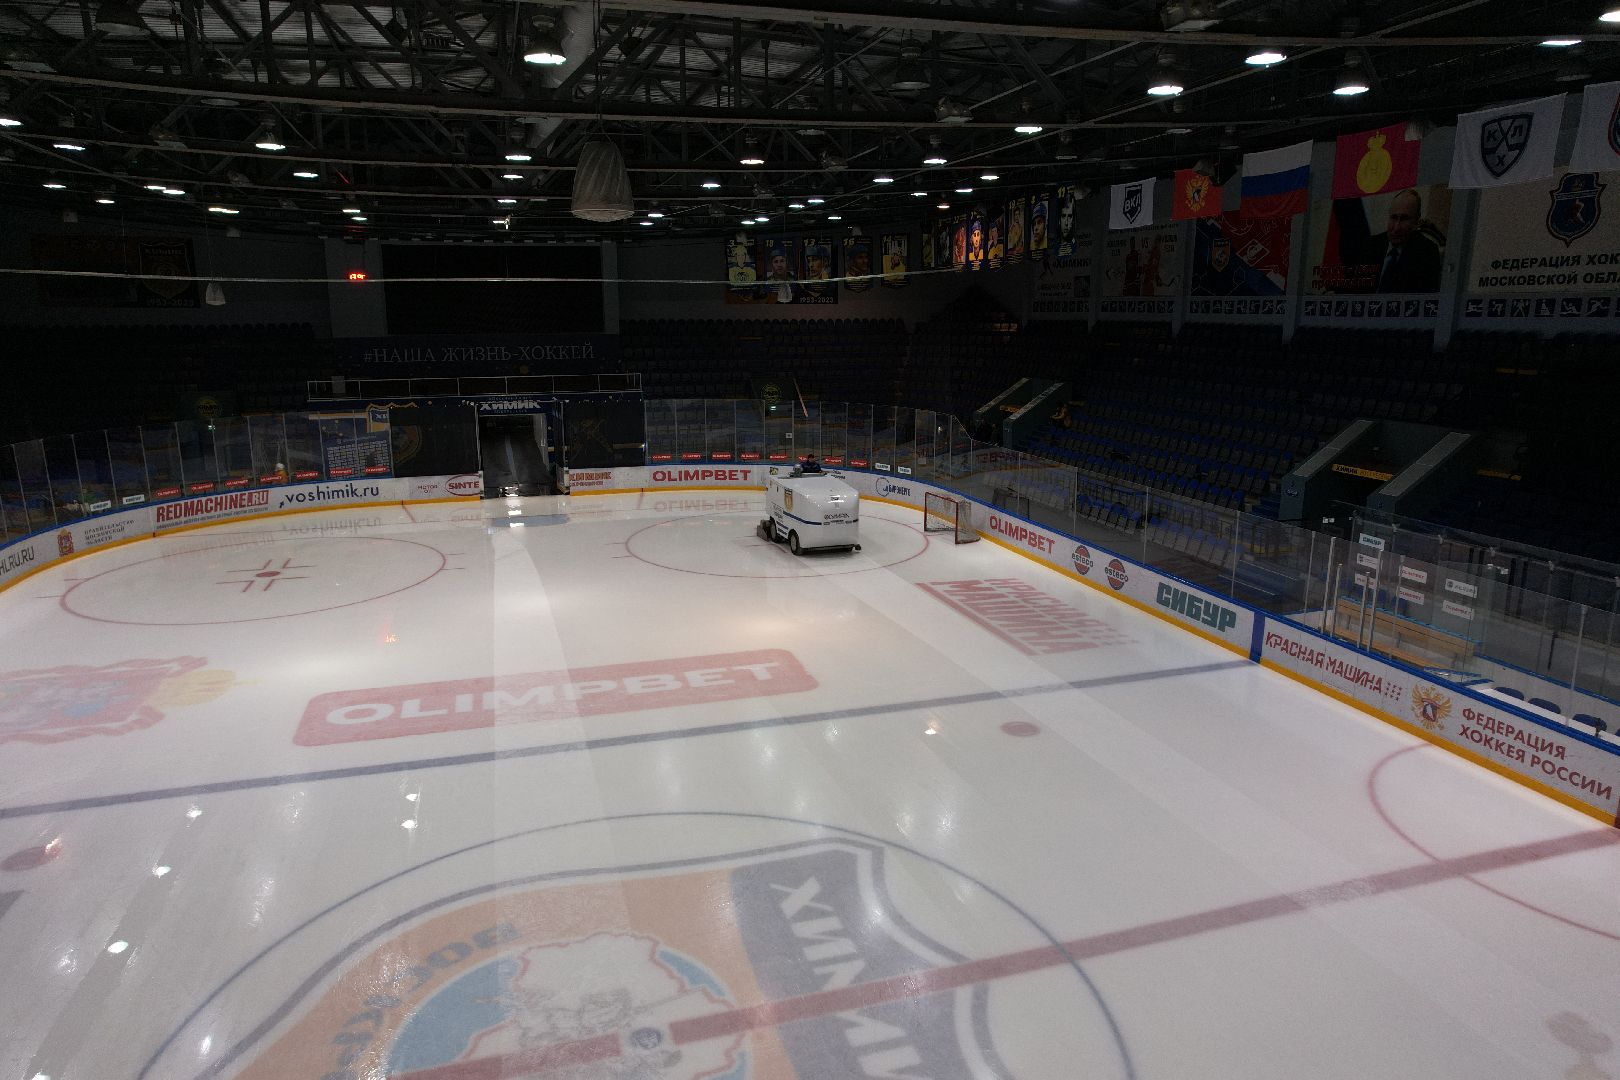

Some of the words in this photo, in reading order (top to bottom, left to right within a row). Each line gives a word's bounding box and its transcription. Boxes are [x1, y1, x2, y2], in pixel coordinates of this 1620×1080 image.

[1491, 254, 1581, 271] ФЕДЕРАЦИЯ
[1478, 271, 1578, 287] МОСКОВСКОЙ
[481, 400, 542, 411] ХИМИК
[652, 469, 751, 482] OLIMPBET
[156, 490, 269, 523] REDMACHINE.RU
[285, 483, 379, 504] voshimik.ru
[989, 515, 1056, 554] OLIMPBET
[1071, 552, 1093, 567] esteco
[1104, 565, 1129, 583] esteco
[1156, 581, 1237, 633] СИБУР
[1265, 631, 1326, 669] КРАСНАЯ
[1325, 656, 1383, 694] МАШИНА
[325, 663, 780, 725] OLIMPBET
[1462, 707, 1567, 761] ФЕДЕРАЦИЯ
[1458, 723, 1526, 764] ХОККЕЯ
[1530, 753, 1613, 801] РОССИИ
